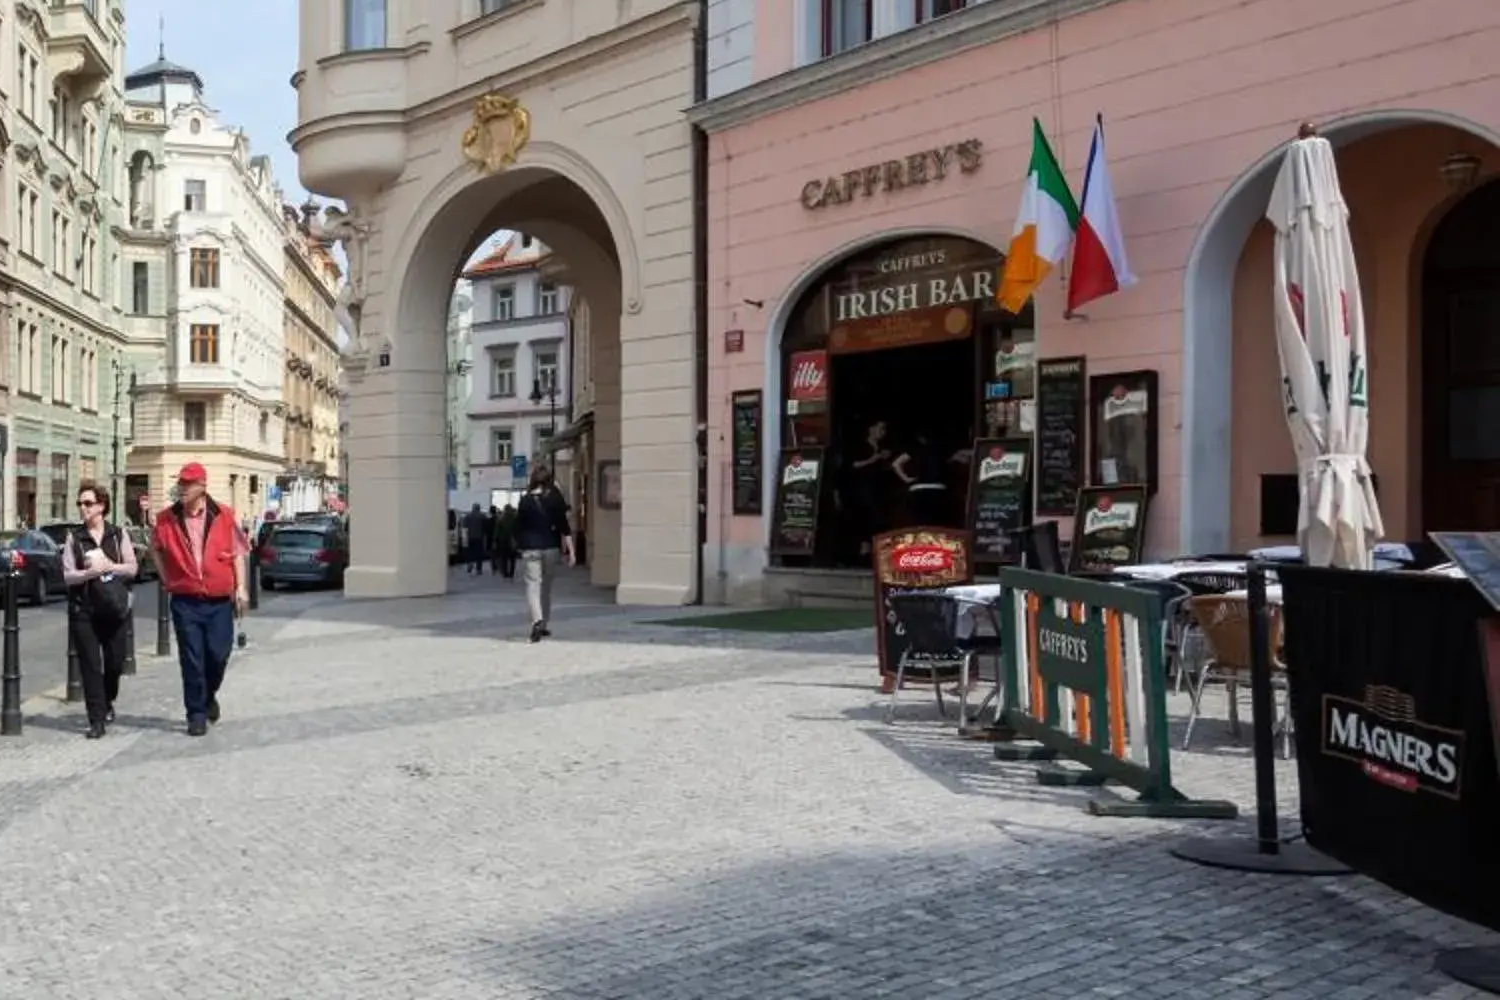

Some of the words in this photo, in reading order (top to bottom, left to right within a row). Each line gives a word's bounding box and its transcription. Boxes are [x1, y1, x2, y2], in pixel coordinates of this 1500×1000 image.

[802, 138, 982, 210] CAFFREY'S
[881, 250, 946, 273] CAFFREY'S
[836, 283, 918, 321] IRISH
[929, 270, 995, 306] BAR
[793, 360, 824, 392] illy
[900, 551, 943, 568] Coca-Cola
[1329, 707, 1457, 784] MAGNERS
